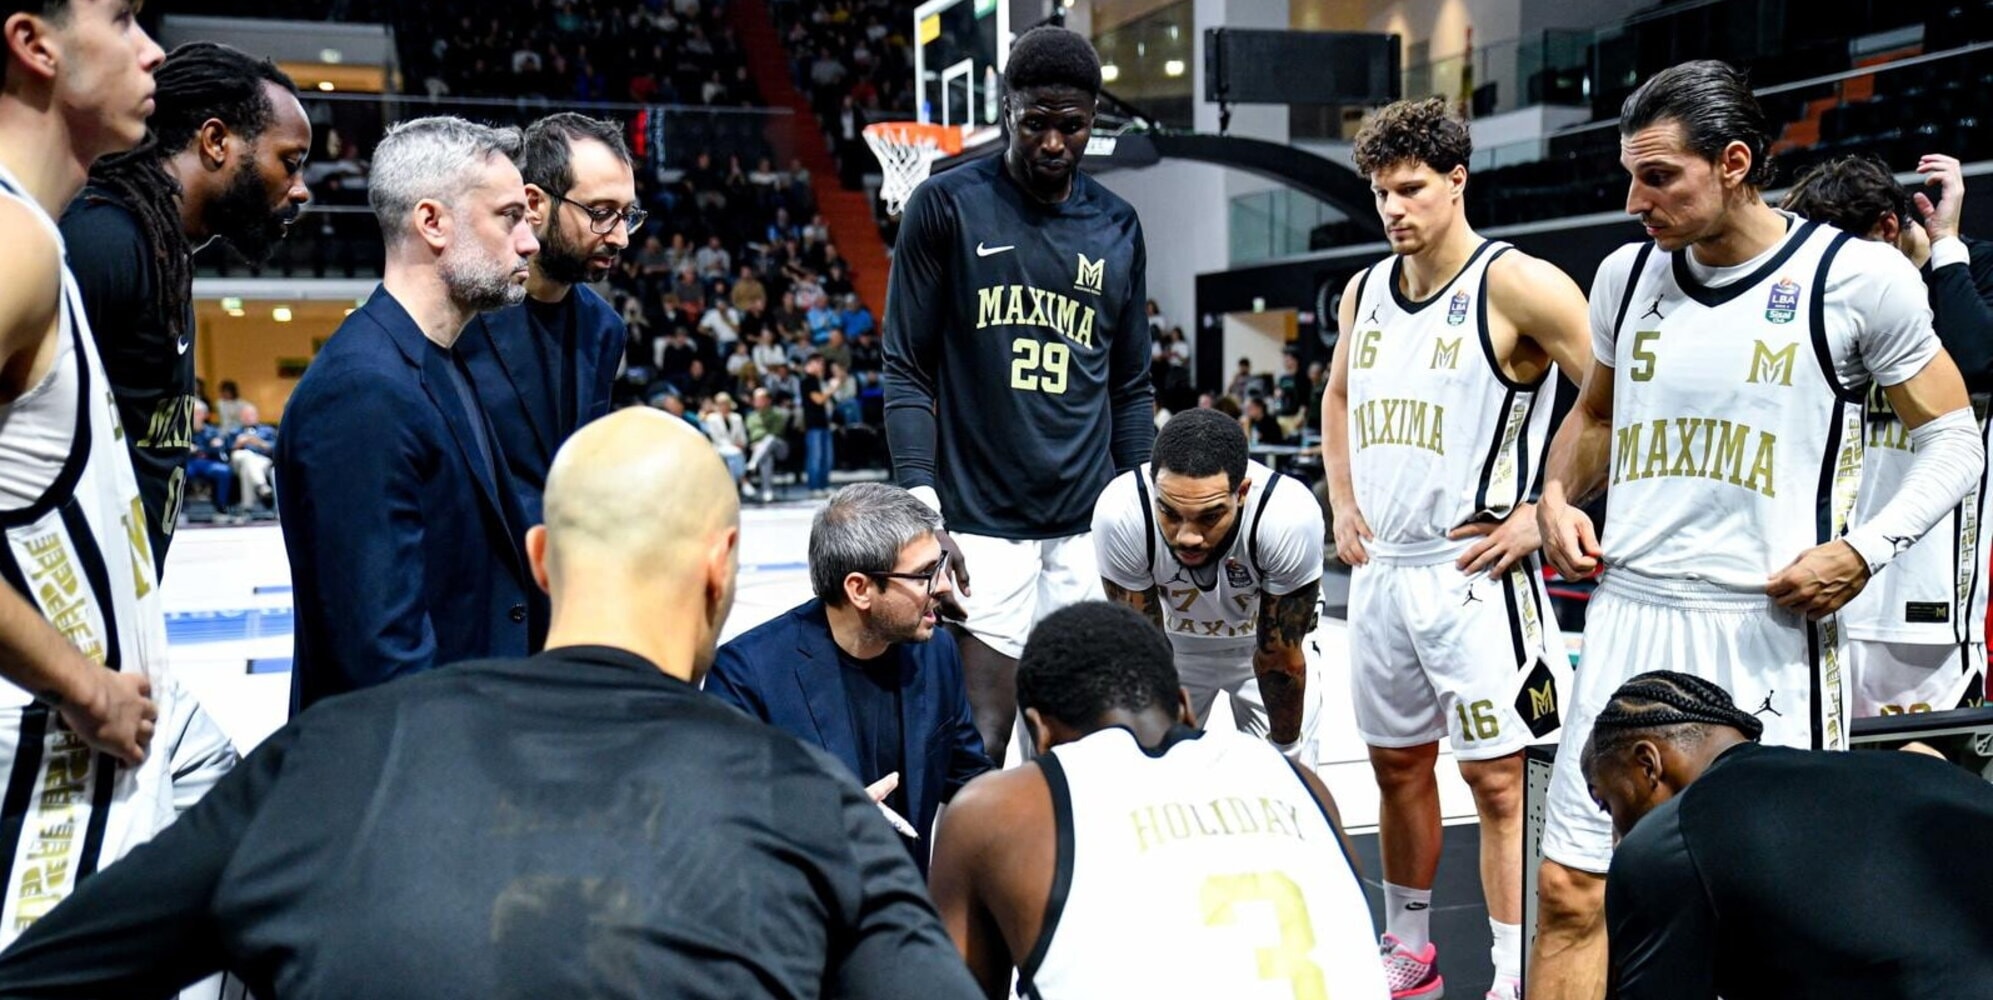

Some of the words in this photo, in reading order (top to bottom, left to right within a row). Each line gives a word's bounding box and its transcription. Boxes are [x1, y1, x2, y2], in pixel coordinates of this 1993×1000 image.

[976, 285, 1095, 350] MAXIMA
[1772, 294, 1796, 304] LBA
[1011, 338, 1070, 394] 29
[1352, 330, 1382, 369] 16
[1630, 331, 1661, 382] 5
[1353, 399, 1445, 456] MAXIMA
[1612, 417, 1777, 498] MAXIMA
[1455, 699, 1500, 742] 16
[1129, 797, 1305, 852] HOLIDAY
[1198, 869, 1331, 1000] 3
